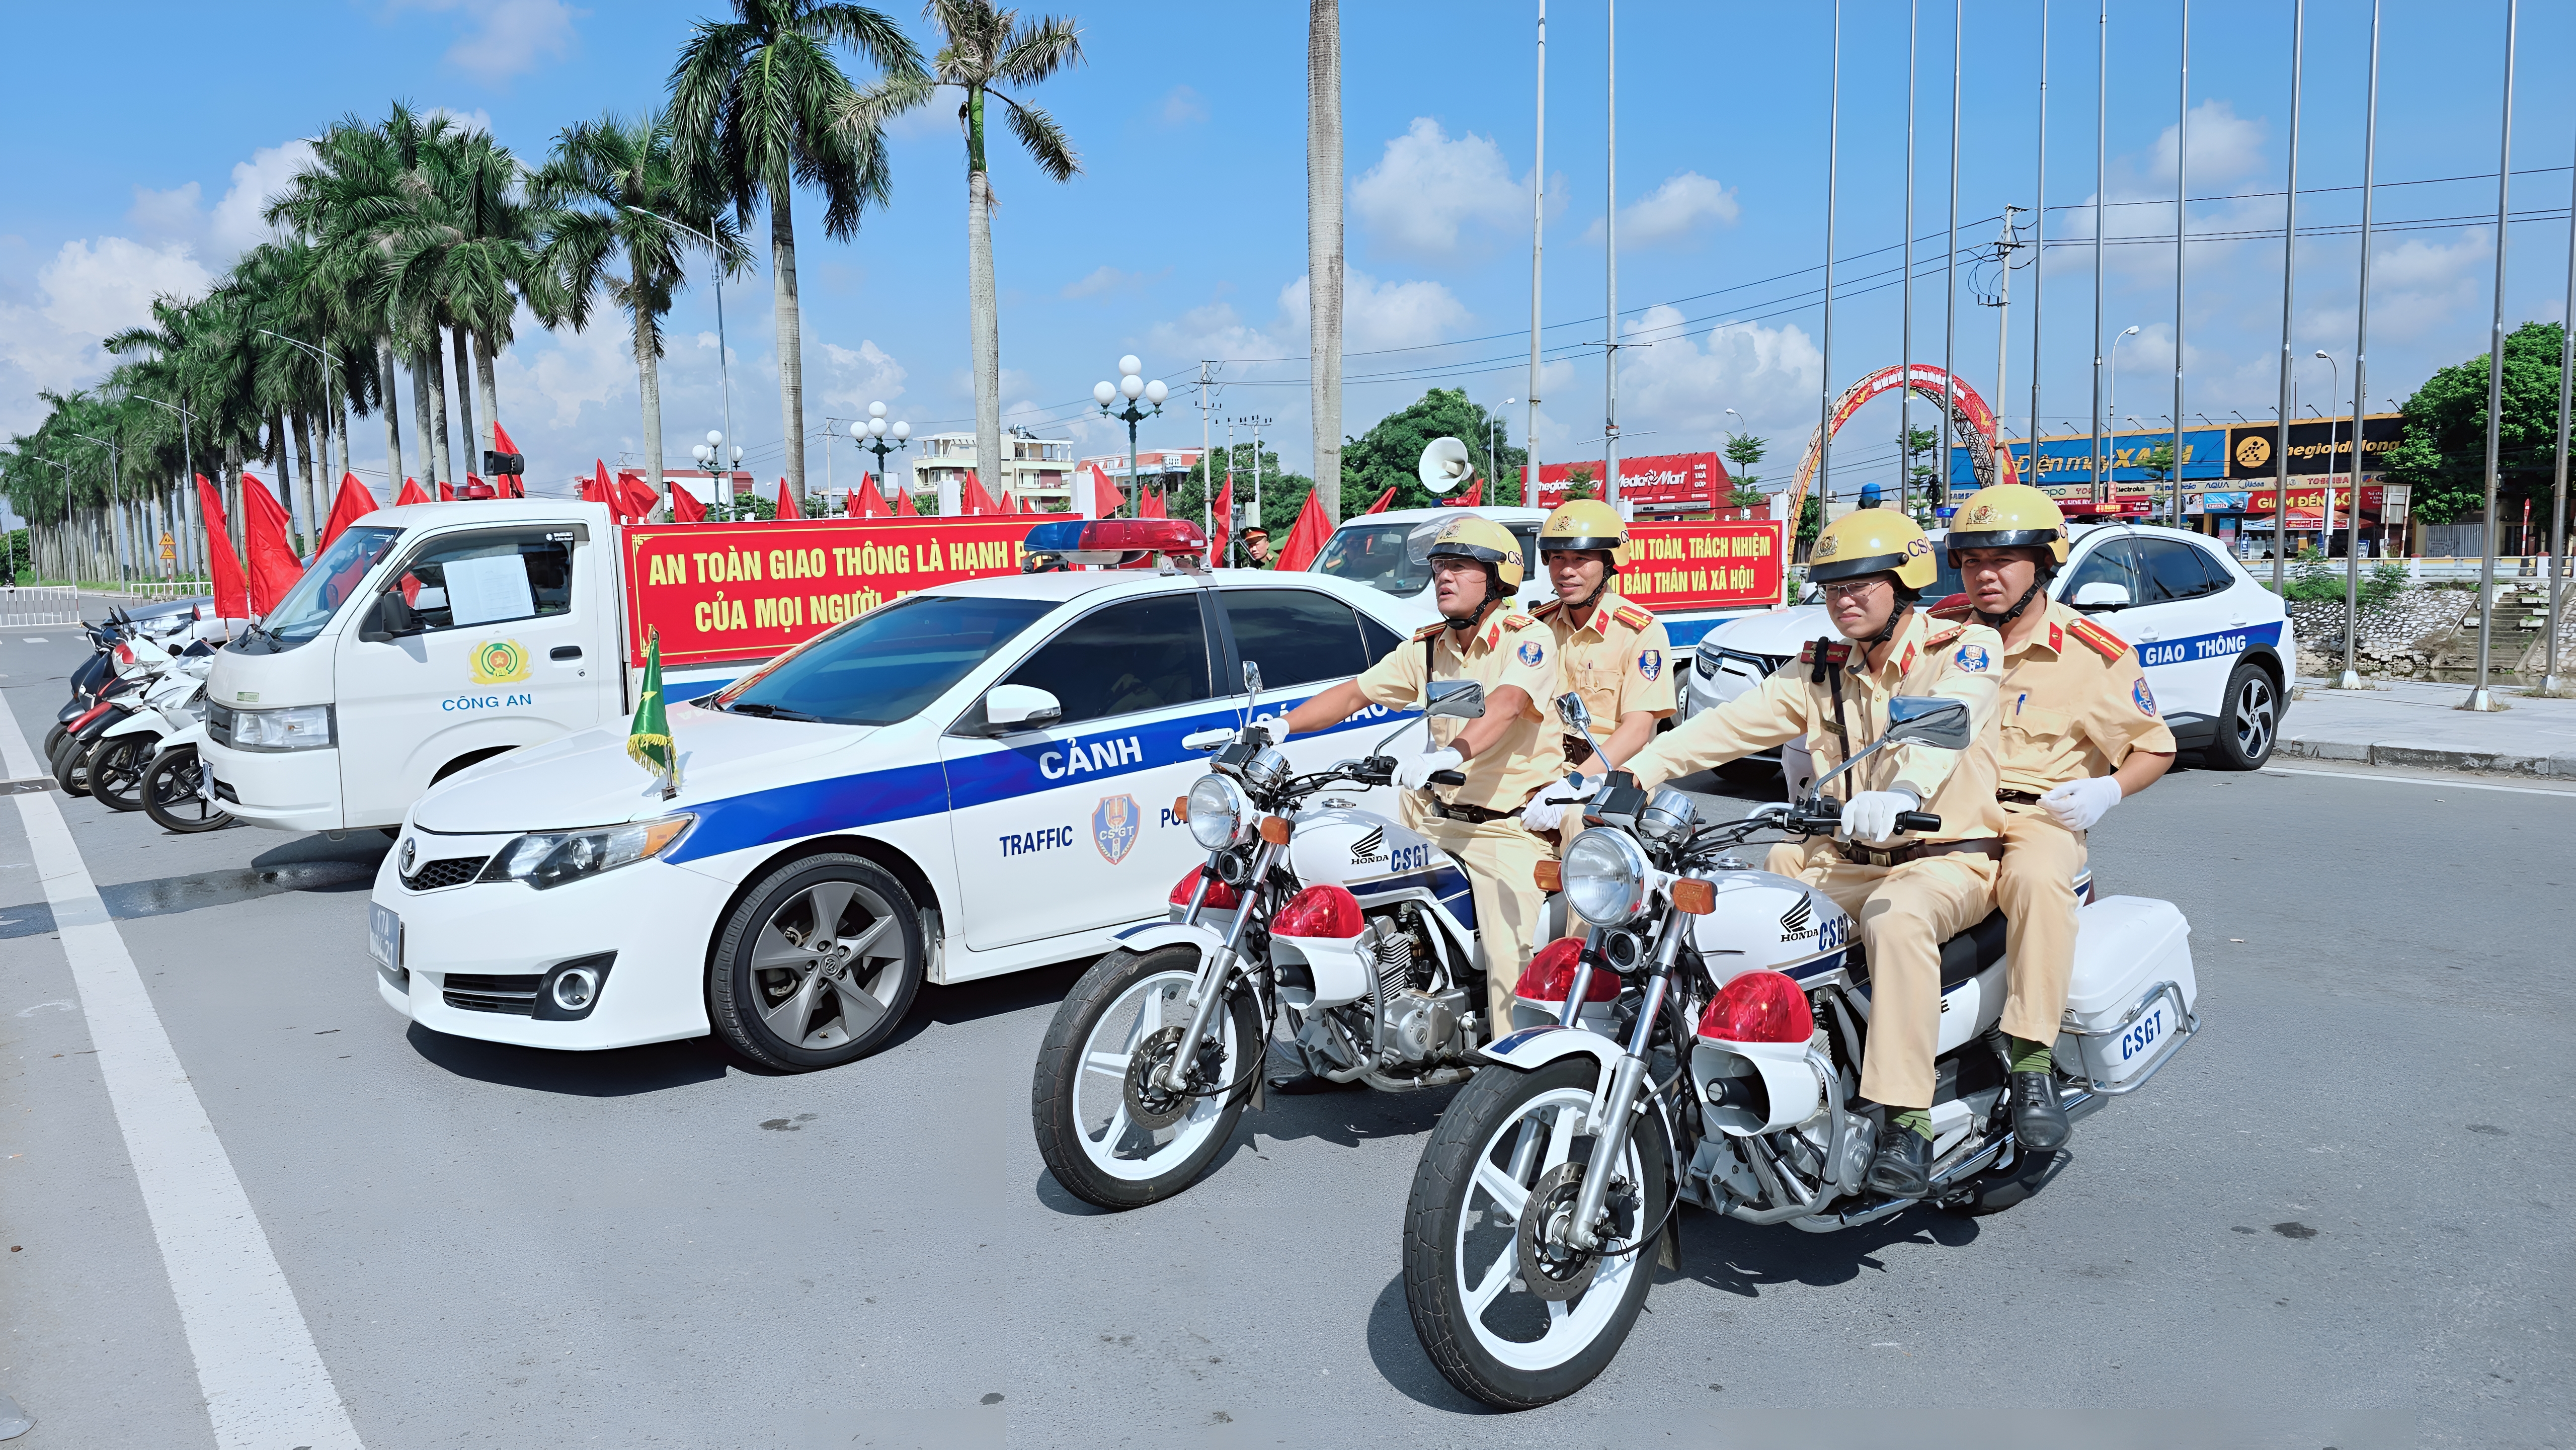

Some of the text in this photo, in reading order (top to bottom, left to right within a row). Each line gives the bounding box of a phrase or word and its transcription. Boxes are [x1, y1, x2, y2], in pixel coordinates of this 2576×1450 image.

[1648, 534, 1685, 561] TOÀN,
[1688, 533, 1728, 558] TRÁCH
[1732, 532, 1770, 561] NHIỆM
[649, 554, 686, 586] AN
[693, 545, 762, 583] TOÀN
[769, 548, 826, 580] GIAO
[833, 540, 910, 576] THÔNG
[916, 538, 944, 572] LÀ
[949, 541, 1008, 576] HẠNH
[1624, 566, 1651, 595] BẢN
[1654, 567, 1688, 593] THÂN
[1691, 566, 1707, 591] VÀ
[1710, 566, 1727, 590] XÃ
[1730, 565, 1754, 593] HỘI!
[695, 591, 748, 632] CỦA
[755, 597, 802, 633] MỌI
[2145, 635, 2246, 665] GIAO THÔNG
[442, 693, 532, 711] CÔNG AN
[1039, 738, 1143, 779] CẢNH
[999, 826, 1073, 857] TRAFFIC
[1099, 826, 1134, 840] CSGT
[1350, 843, 1429, 872] HONDA CSGT
[1780, 929, 1819, 942] HONDA
[2122, 1009, 2161, 1061] CSGT
